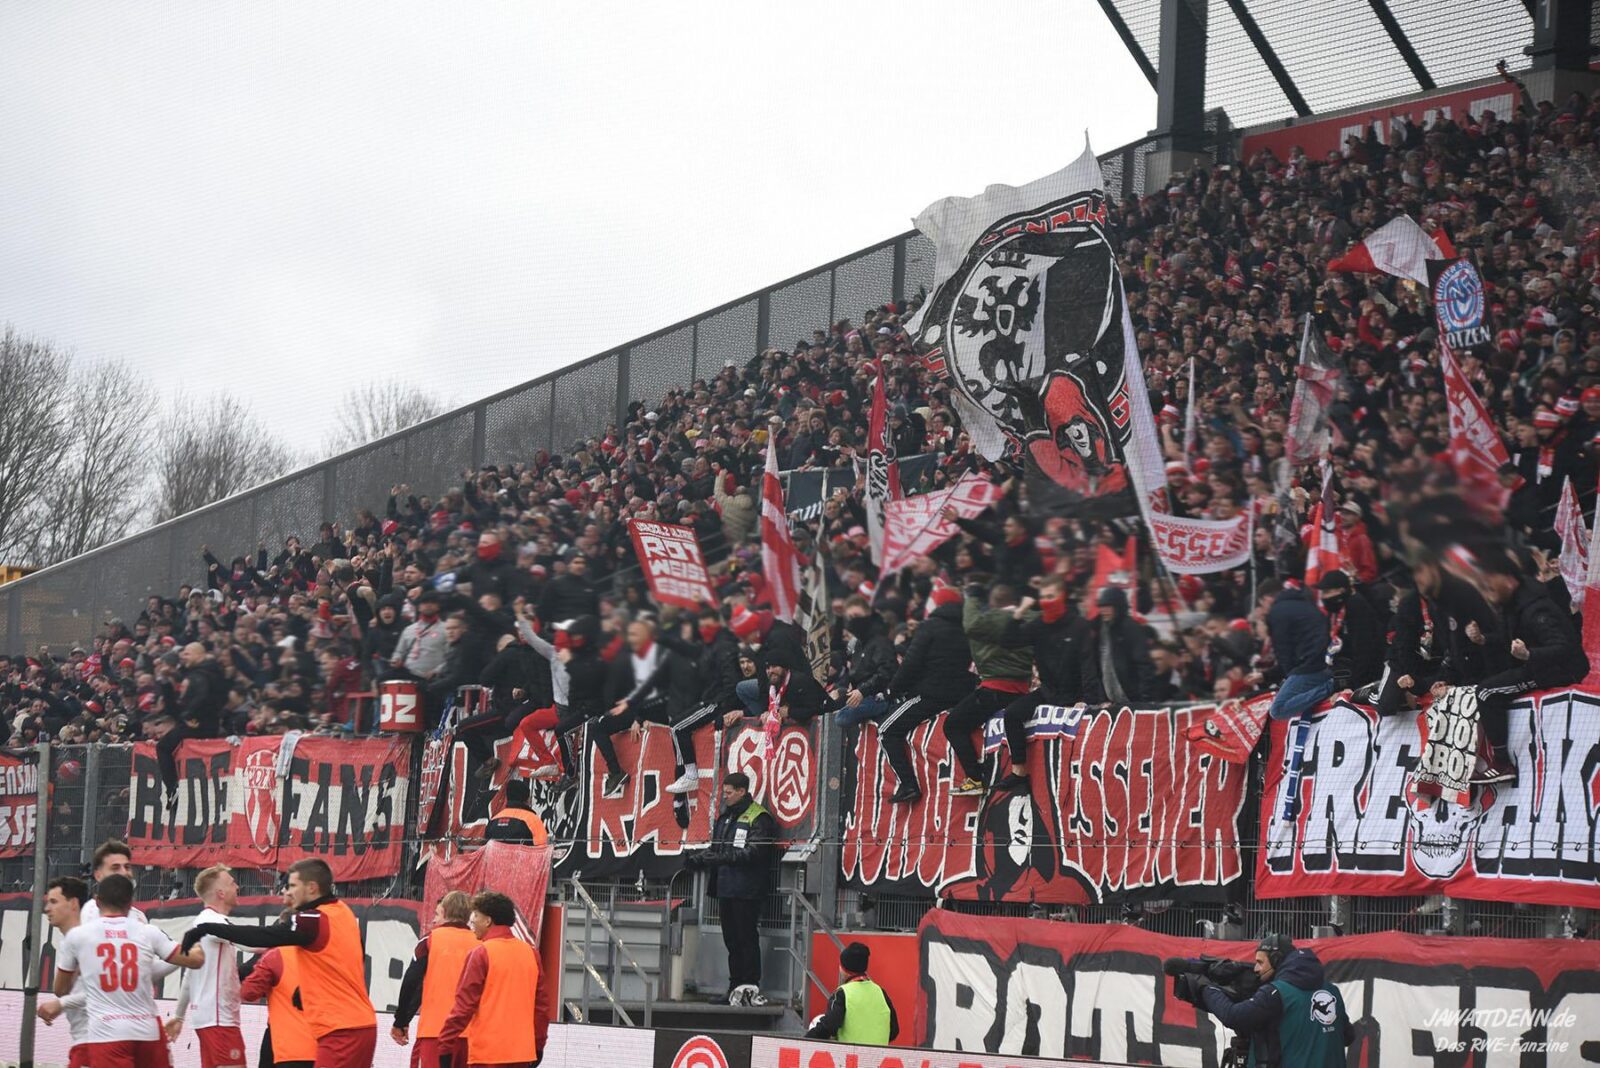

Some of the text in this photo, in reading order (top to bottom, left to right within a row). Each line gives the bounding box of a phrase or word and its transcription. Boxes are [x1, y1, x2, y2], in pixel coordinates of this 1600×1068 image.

[1444, 324, 1491, 349] OTZEN
[640, 535, 702, 565] ROT
[279, 755, 397, 856] FANS
[1056, 706, 1249, 892] ESSENER
[96, 942, 139, 993] 38
